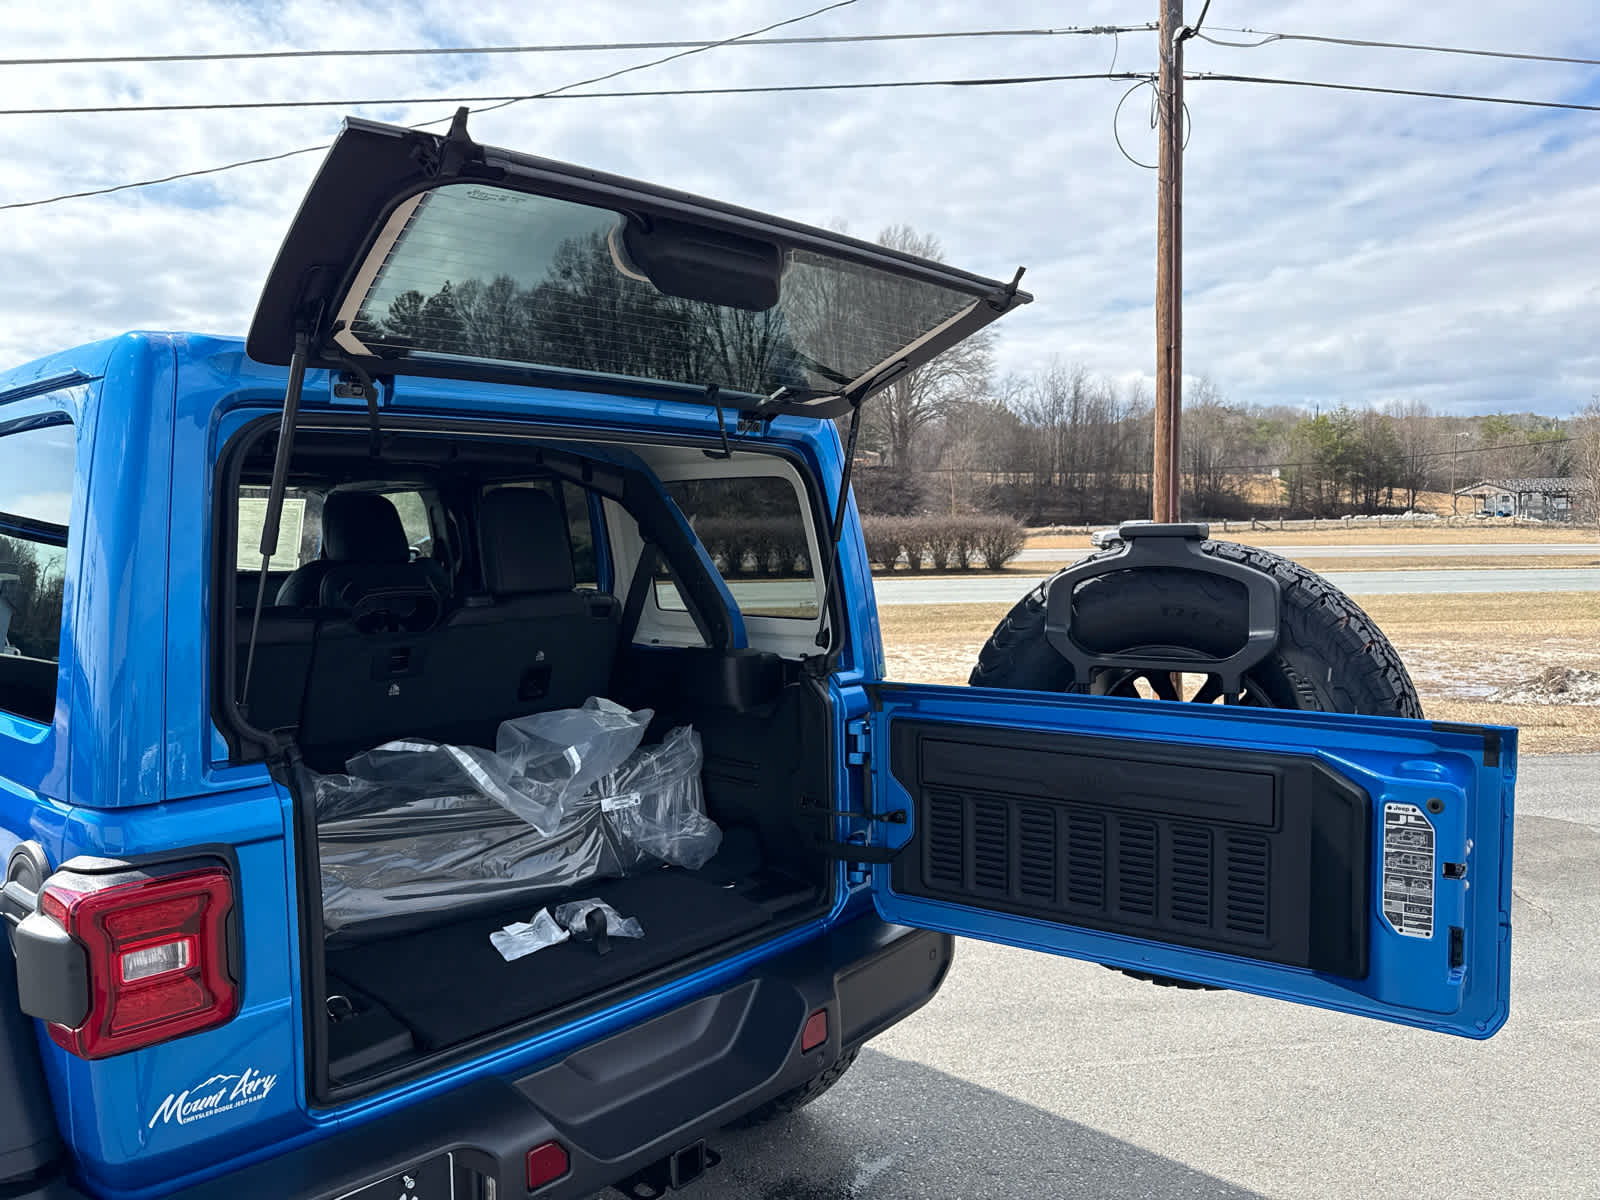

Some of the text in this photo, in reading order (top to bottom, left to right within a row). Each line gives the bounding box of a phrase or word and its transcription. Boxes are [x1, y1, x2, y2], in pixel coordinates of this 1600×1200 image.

[148, 1067, 277, 1129] Mount Airy
[182, 1109, 214, 1124] CHRYSLER
[214, 1103, 233, 1114] DODGE
[233, 1098, 248, 1108] JEEP
